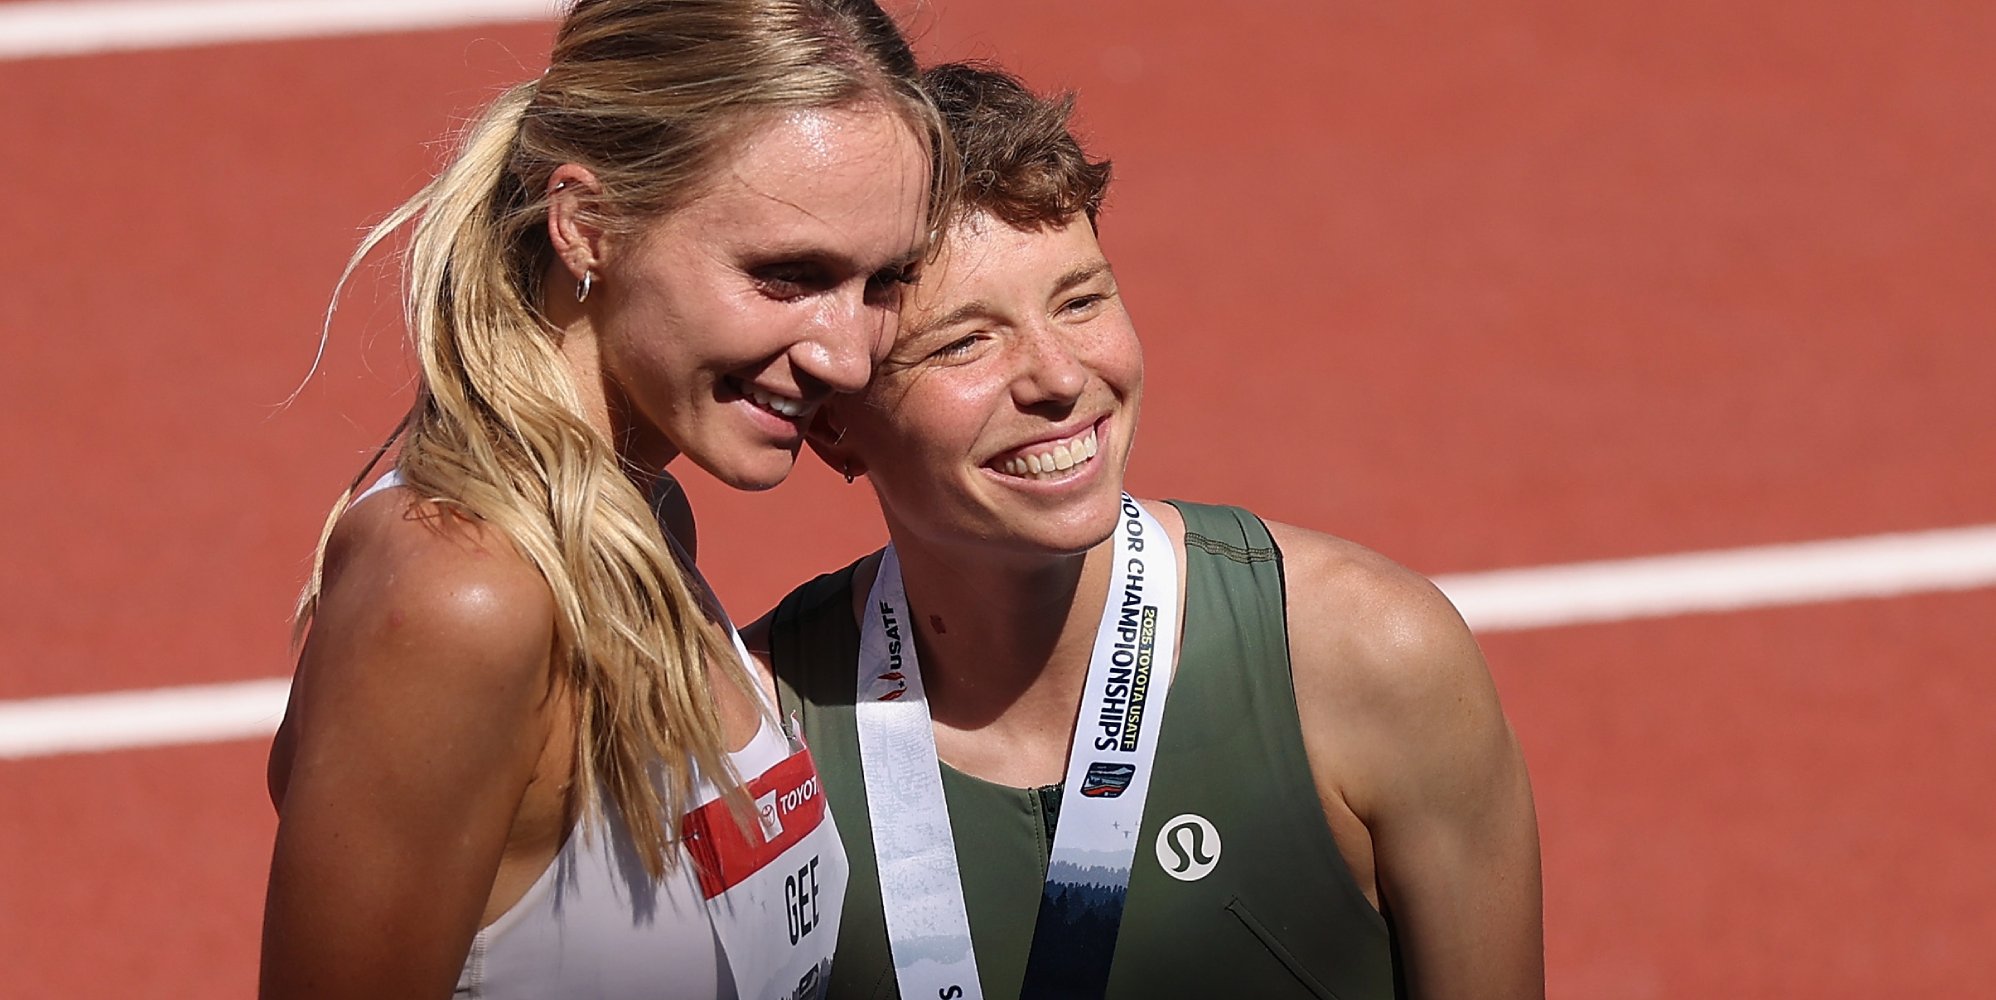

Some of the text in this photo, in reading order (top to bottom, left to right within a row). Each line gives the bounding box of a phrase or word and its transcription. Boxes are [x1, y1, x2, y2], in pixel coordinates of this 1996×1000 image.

[879, 600, 903, 670] USATF
[1094, 558, 1145, 752] CHAMPIONSHIPS
[1123, 609, 1155, 749] 2025 TOYOTA USATF
[780, 775, 819, 815] TOYOT
[785, 855, 819, 946] GEE
